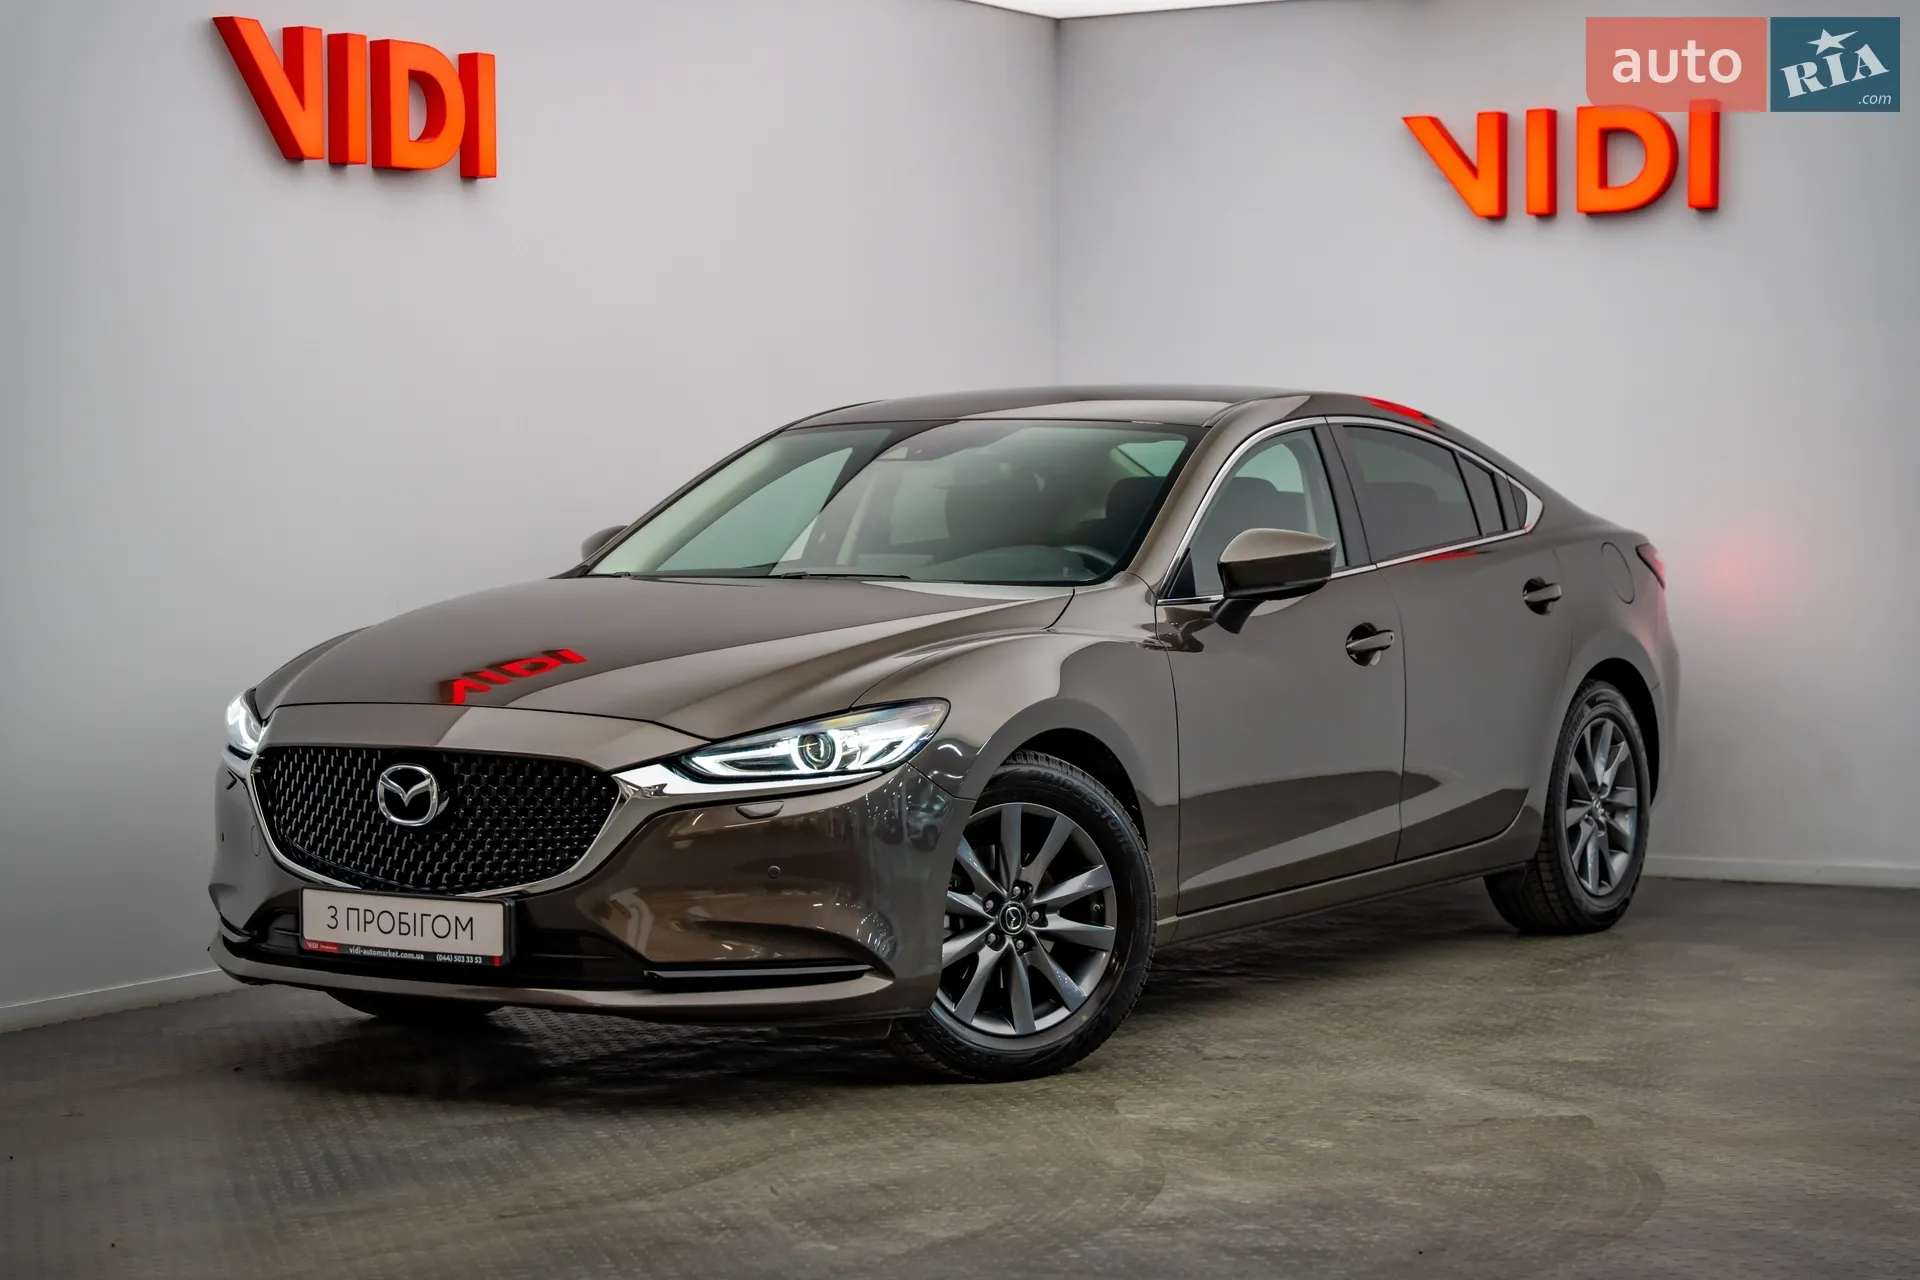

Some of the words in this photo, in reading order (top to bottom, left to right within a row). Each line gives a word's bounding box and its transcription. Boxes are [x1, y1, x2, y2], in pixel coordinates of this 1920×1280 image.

[212, 15, 497, 179] VIDI
[1402, 98, 1721, 220] VIDI
[346, 907, 474, 941] ПРОБІГОМ
[349, 945, 425, 960] vidi-automarket.com.ua
[436, 953, 453, 962] (044)
[453, 955, 465, 963] 503
[465, 955, 474, 964] 33
[474, 956, 483, 964] 53
